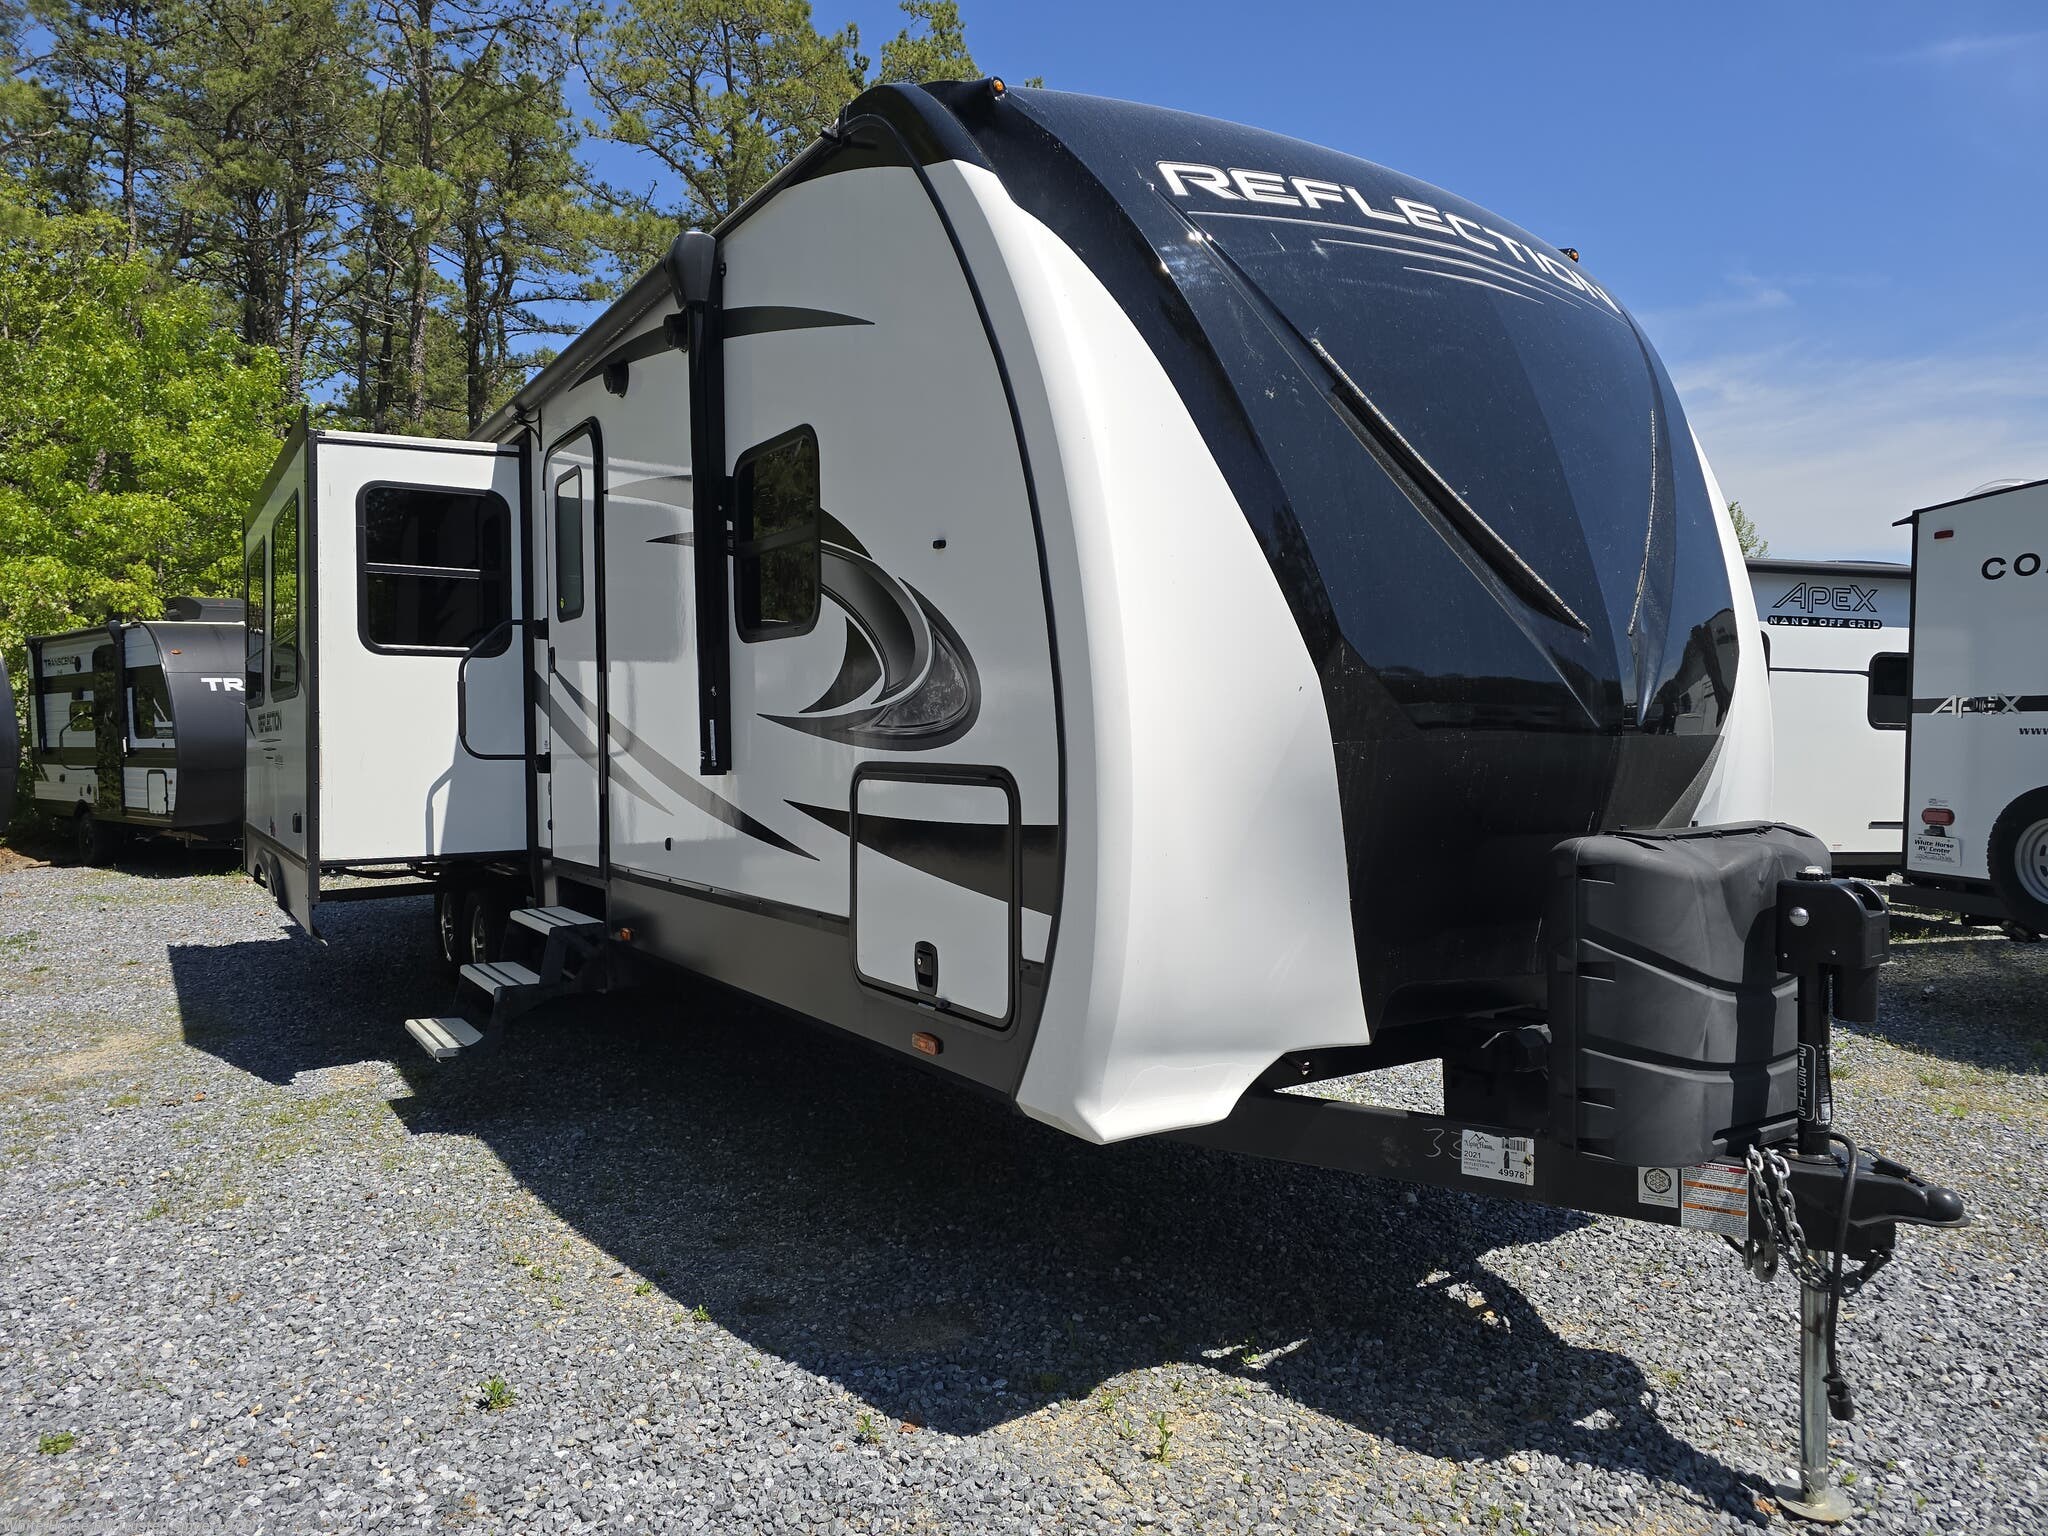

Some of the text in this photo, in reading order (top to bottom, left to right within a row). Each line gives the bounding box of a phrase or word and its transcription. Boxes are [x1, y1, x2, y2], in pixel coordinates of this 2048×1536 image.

[1155, 160, 1621, 314] REFLECTION
[1981, 552, 2048, 580] CO
[1772, 582, 1879, 613] APEX
[1769, 616, 1881, 629] NANO OFF GRID
[200, 677, 246, 692] TR
[1463, 1150, 1481, 1159] 2021
[1498, 1168, 1525, 1179] 49978
[1705, 1164, 1730, 1172] DANGER
[1704, 1183, 1731, 1192] WARNING
[1704, 1205, 1731, 1214] WARNING
